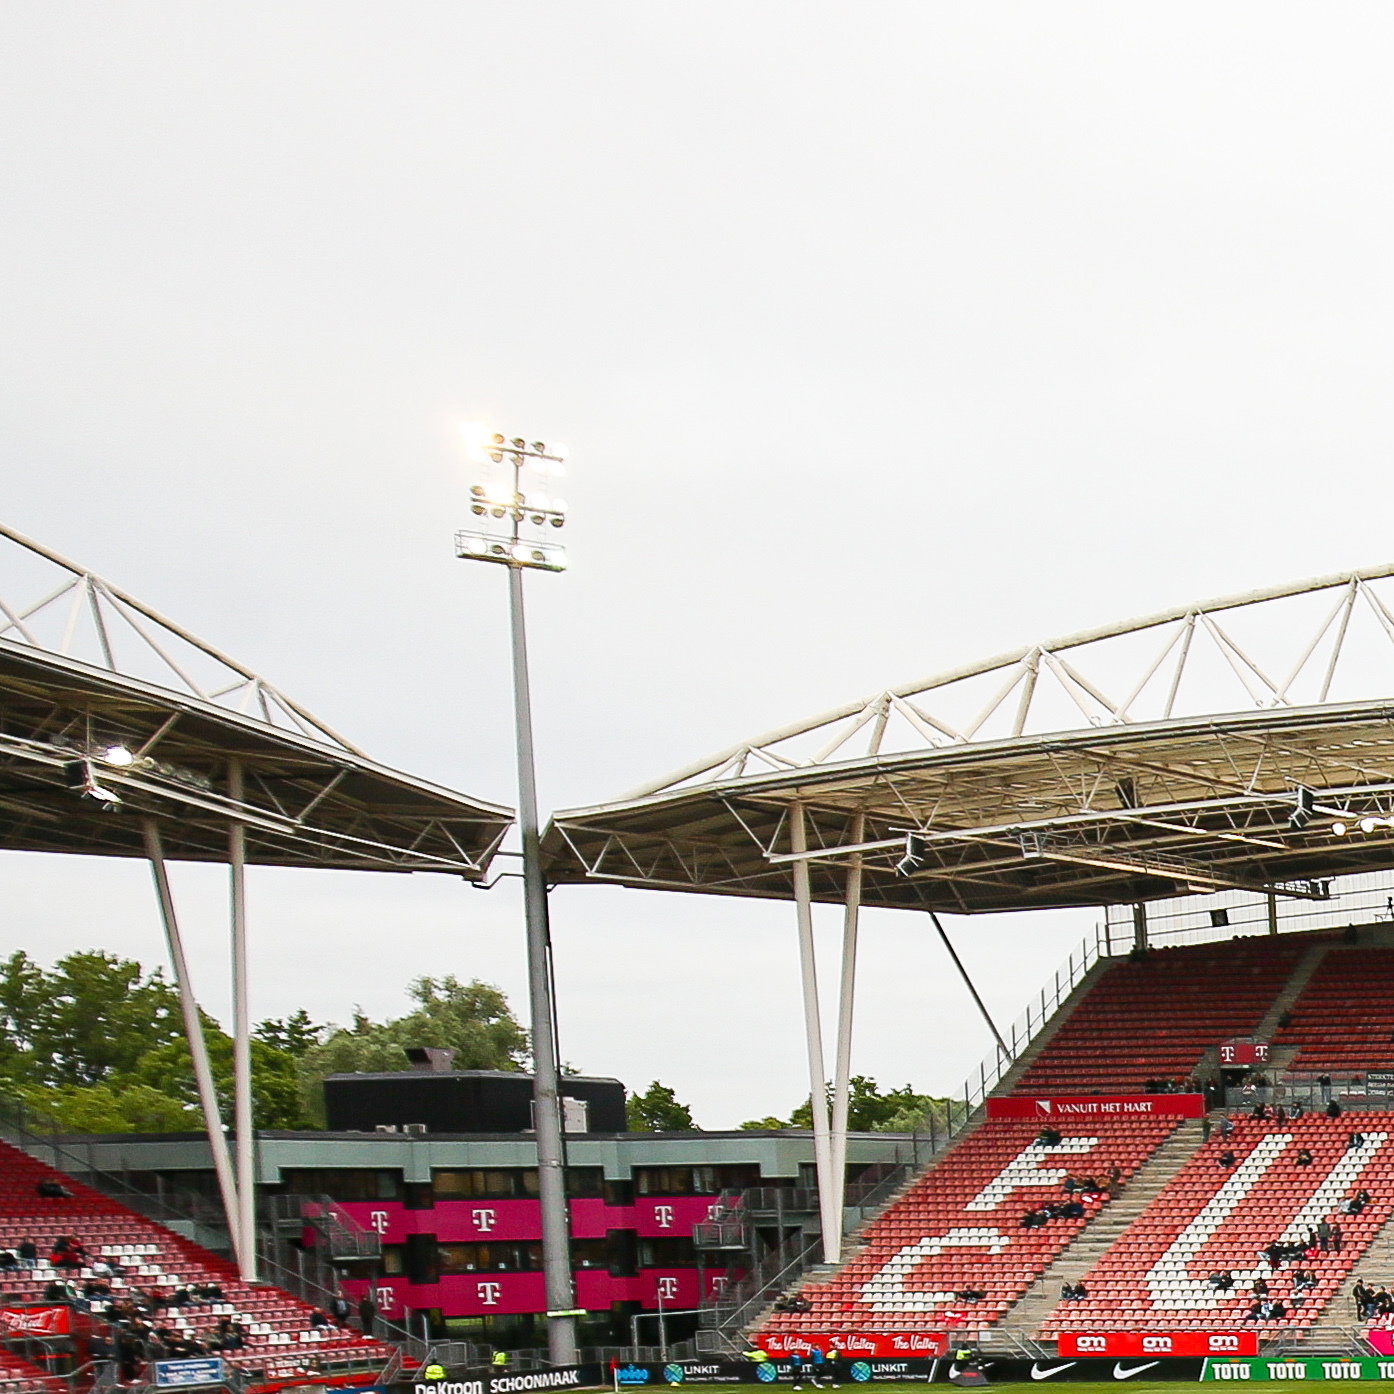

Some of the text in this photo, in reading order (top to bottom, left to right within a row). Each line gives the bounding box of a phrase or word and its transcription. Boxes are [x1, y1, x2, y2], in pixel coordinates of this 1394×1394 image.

[1057, 1102, 1152, 1114] VANUIT HET HART
[684, 1365, 719, 1375] LINKIT
[777, 1364, 812, 1373] LINIT
[872, 1364, 907, 1373] LINKIT
[1212, 1363, 1250, 1379] TOTO
[1267, 1362, 1306, 1379] TOTO
[1322, 1362, 1361, 1379] TOTO
[490, 1371, 578, 1393] SCHOONMAAK
